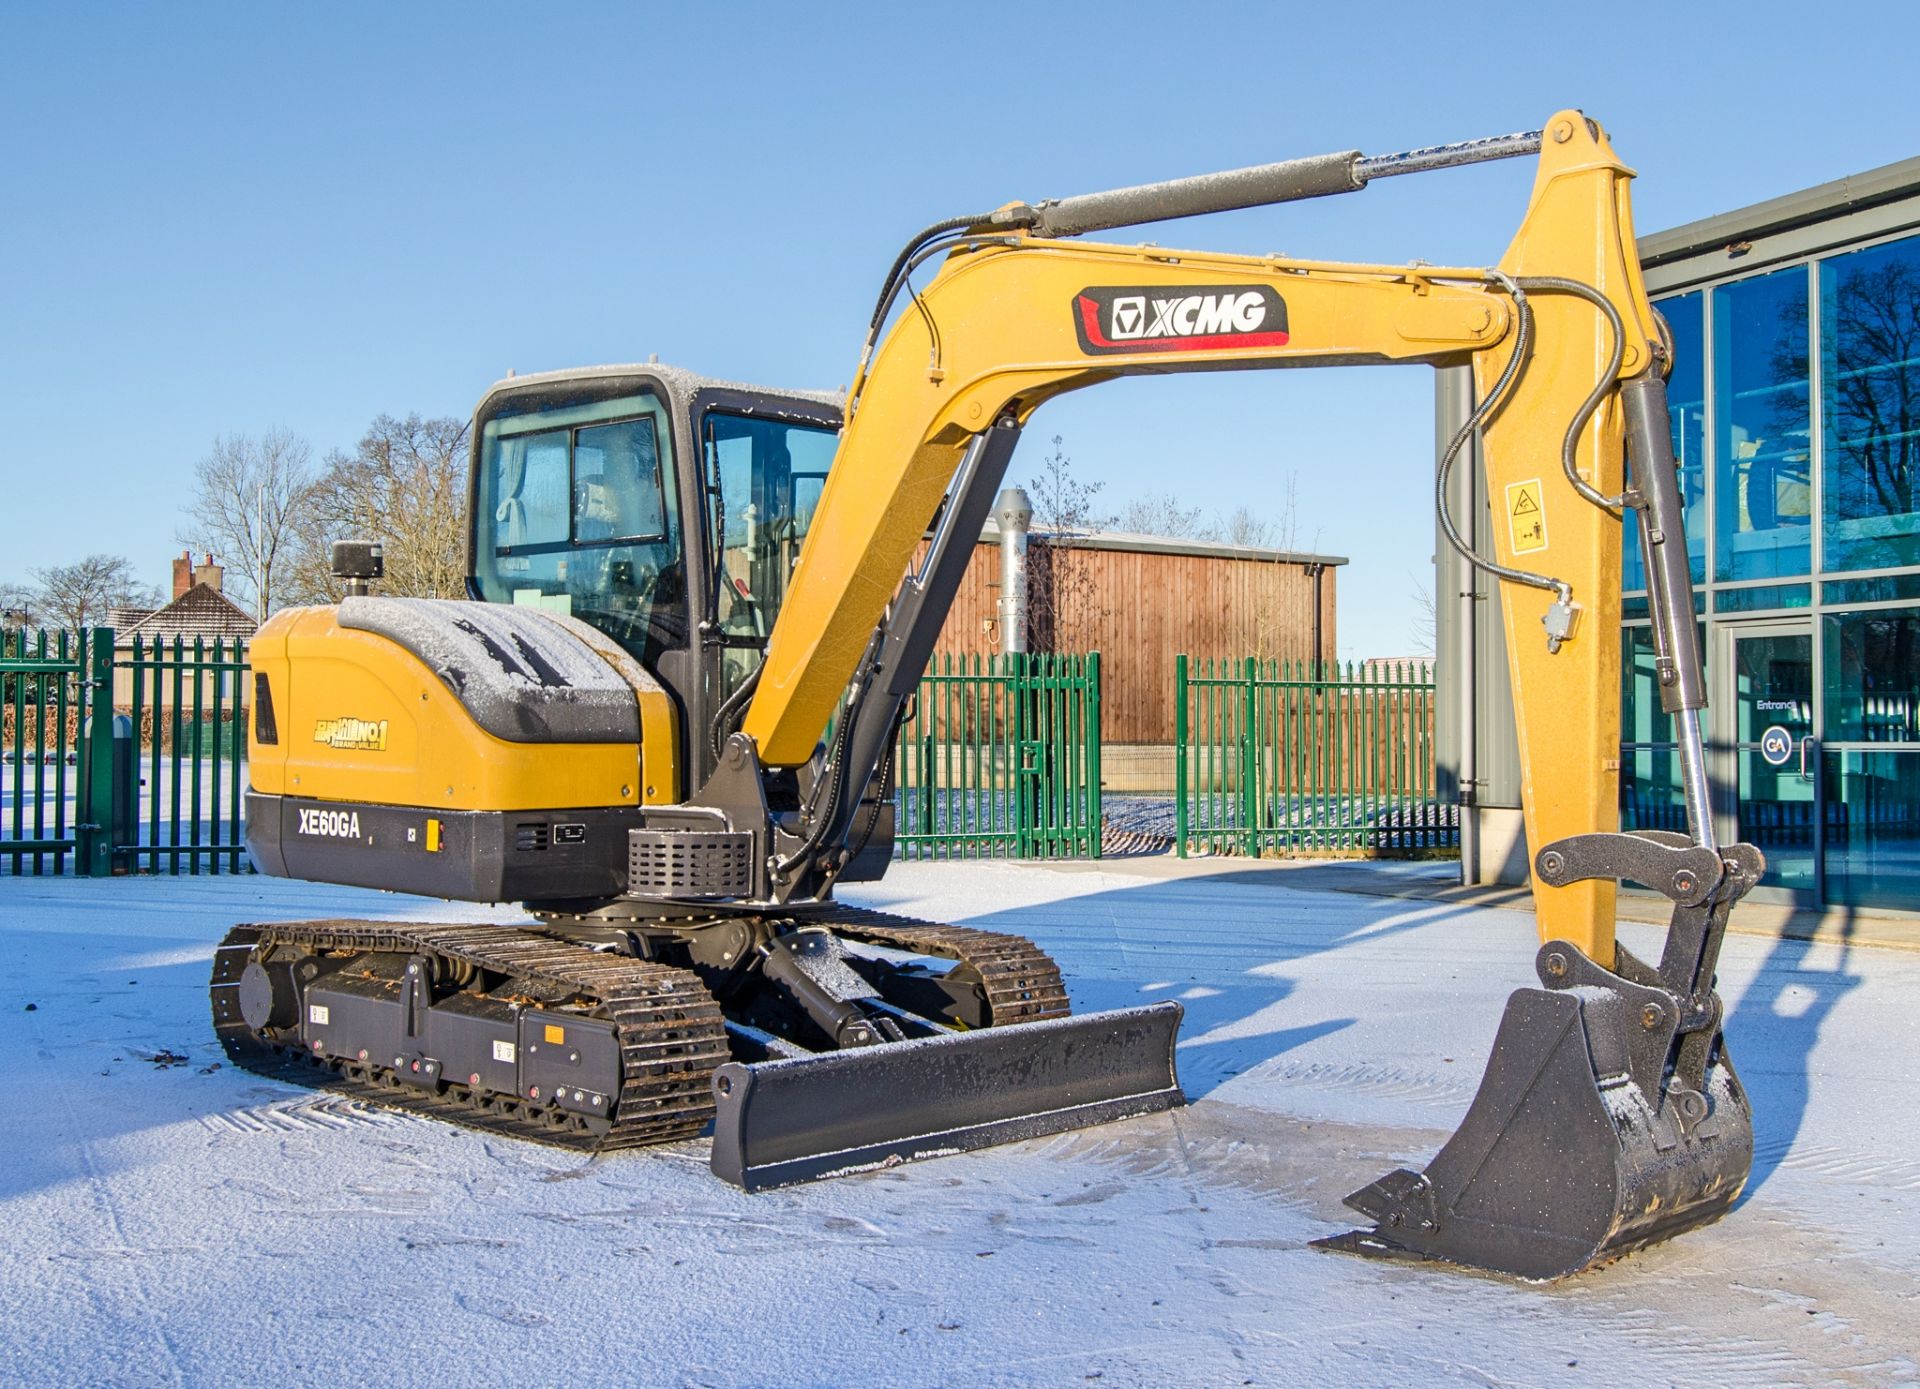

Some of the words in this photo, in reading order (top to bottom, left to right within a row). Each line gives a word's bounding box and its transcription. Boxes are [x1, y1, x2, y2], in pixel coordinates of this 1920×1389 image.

[1142, 291, 1266, 337] XCMG
[1757, 700, 1797, 710] Entranc
[299, 809, 360, 838] XE60GA
